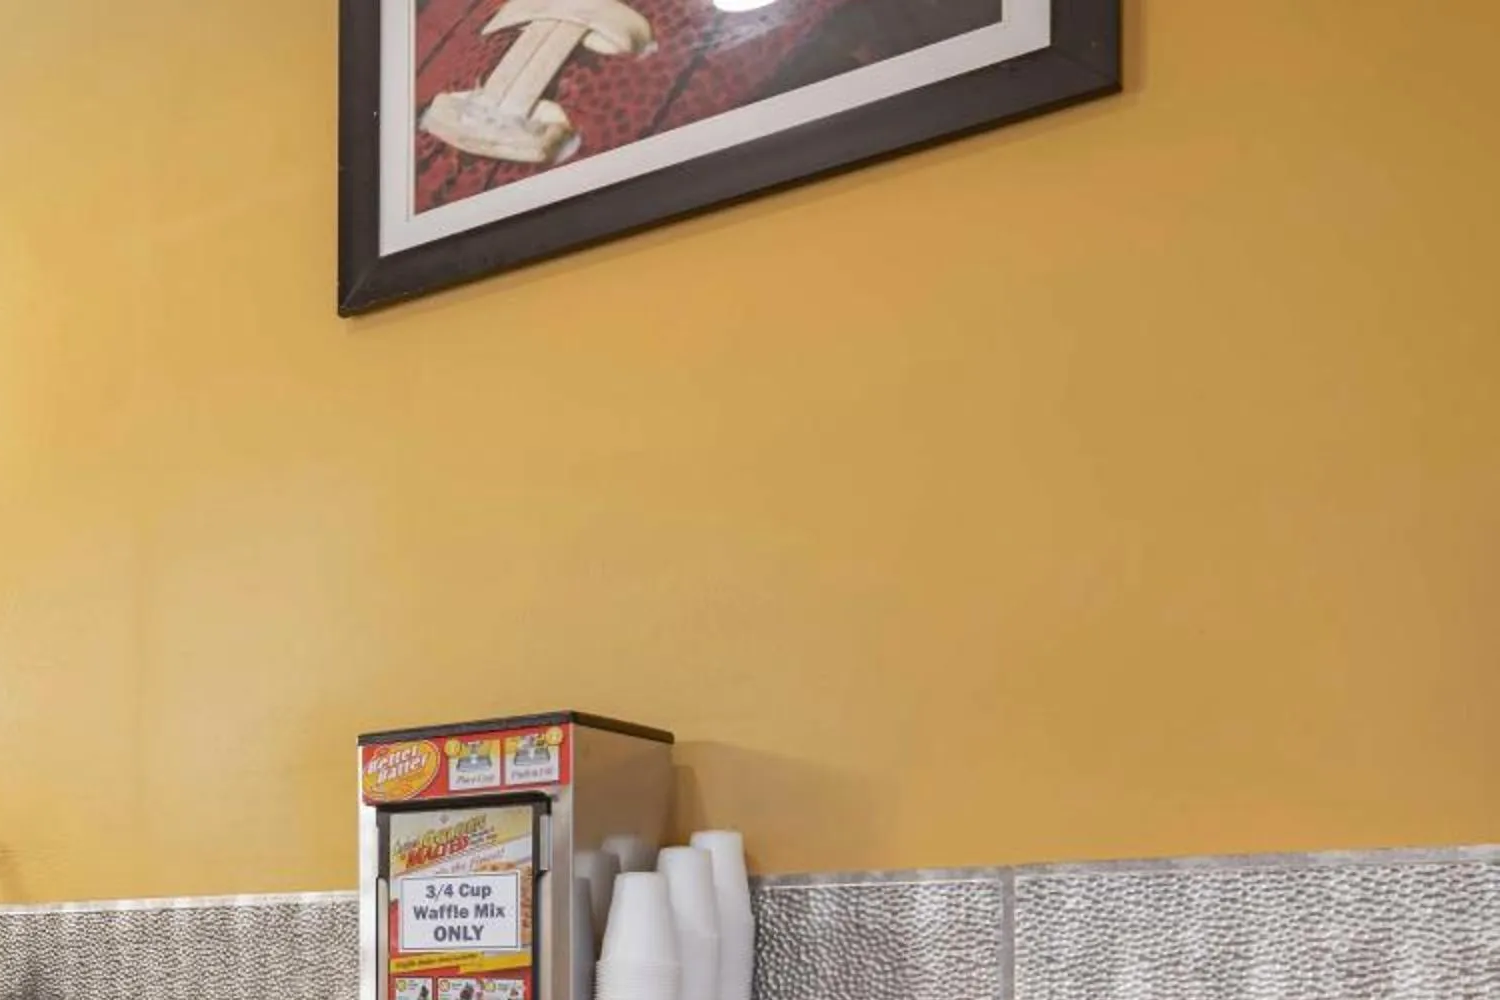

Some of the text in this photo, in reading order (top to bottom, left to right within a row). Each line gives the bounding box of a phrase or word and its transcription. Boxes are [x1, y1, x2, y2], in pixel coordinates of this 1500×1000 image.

[425, 883, 492, 900] 3/4 Cup
[413, 902, 506, 920] Waffle Mix
[433, 925, 484, 942] ONLY
